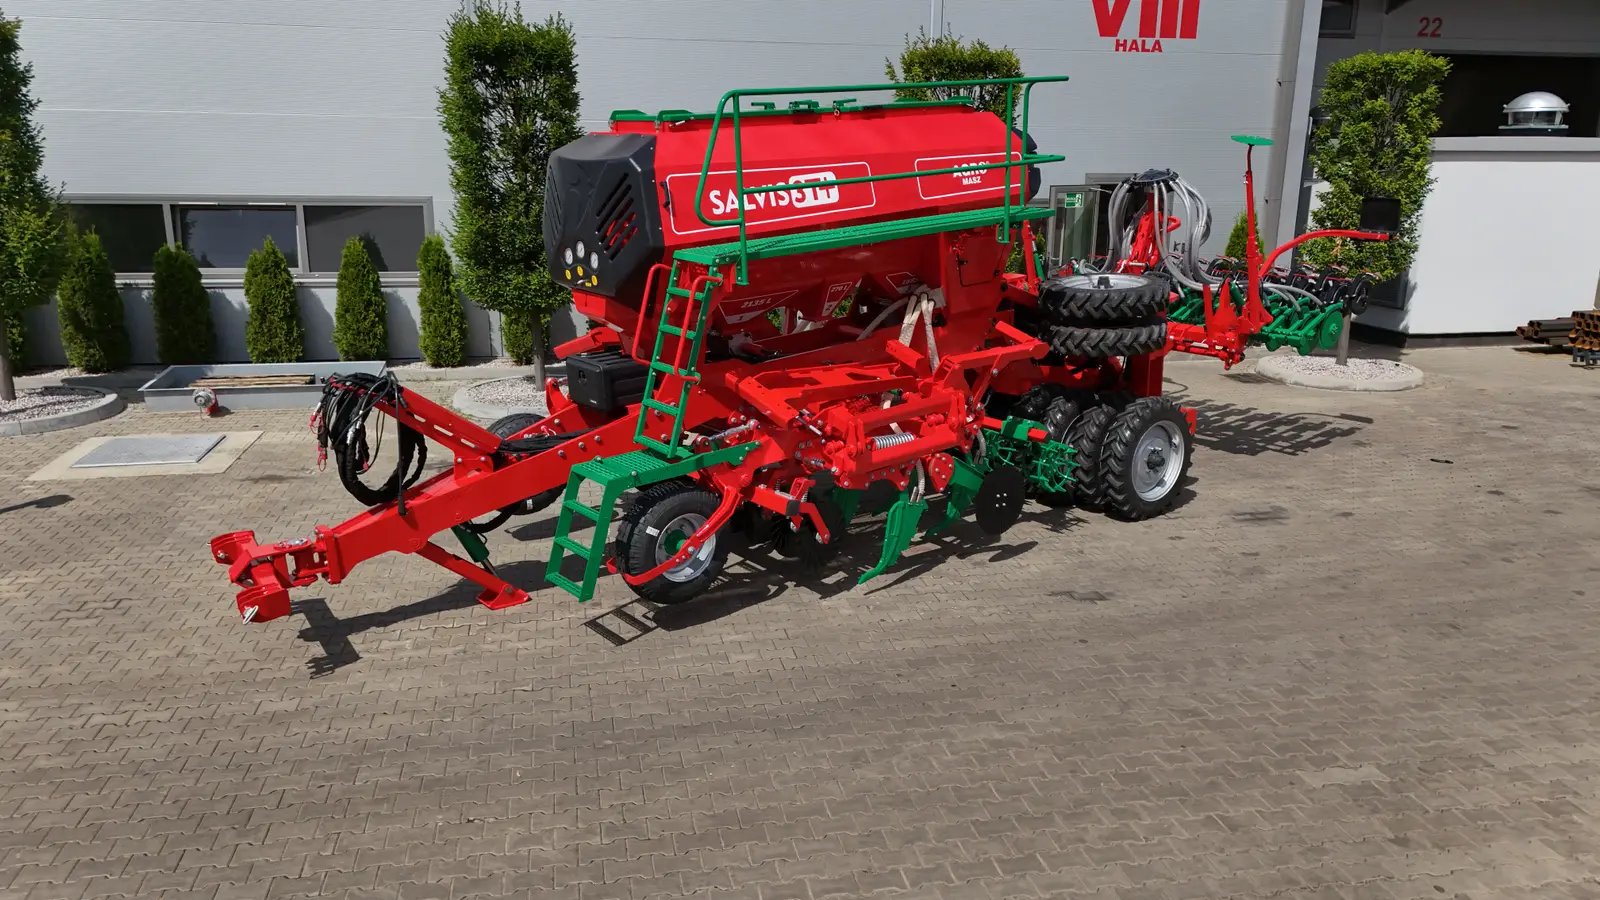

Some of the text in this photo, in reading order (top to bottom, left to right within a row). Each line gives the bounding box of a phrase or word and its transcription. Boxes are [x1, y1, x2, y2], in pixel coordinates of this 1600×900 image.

[1417, 16, 1443, 38] 22
[1114, 38, 1163, 53] HALA
[962, 176, 982, 185] MASZ
[709, 181, 790, 215] SALVIS
